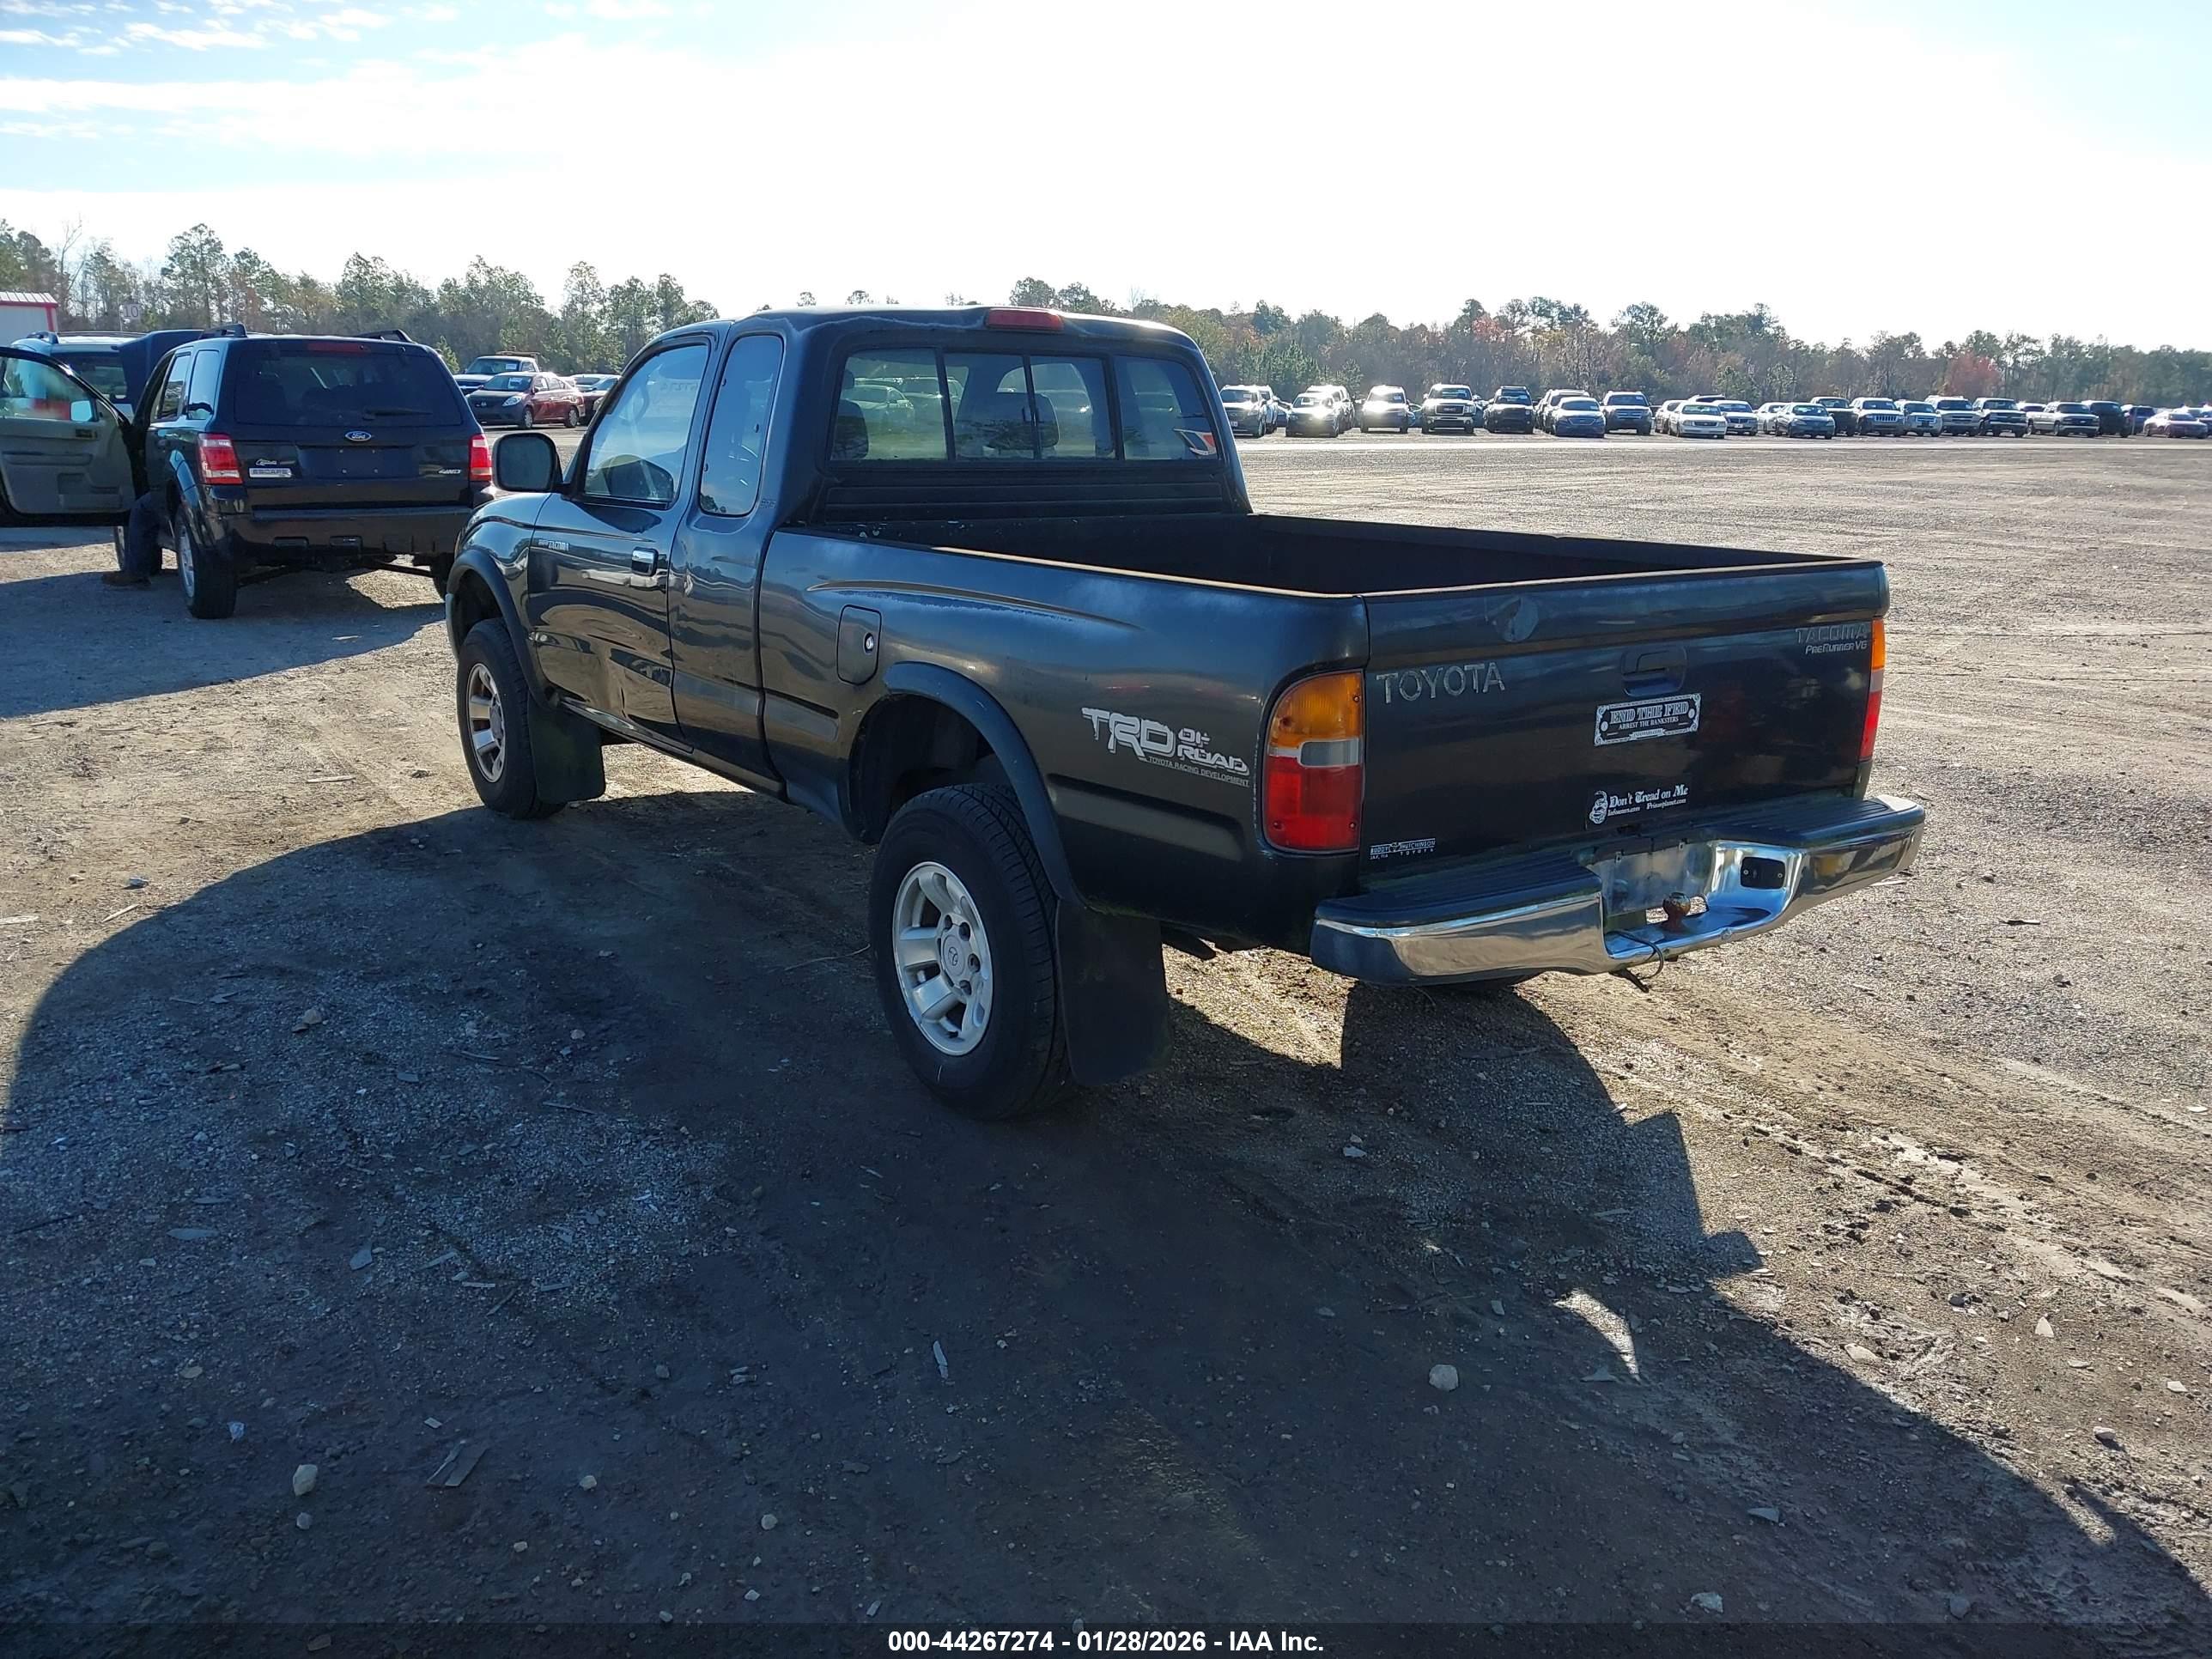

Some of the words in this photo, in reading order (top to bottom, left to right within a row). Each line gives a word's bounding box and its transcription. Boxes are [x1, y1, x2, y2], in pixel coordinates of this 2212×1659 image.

[124, 306, 139, 318] 10
[1376, 662, 1505, 703] TOYOTA
[1609, 708, 1636, 724] END
[1637, 704, 1663, 720] THE
[1663, 701, 1689, 716] FED
[1081, 708, 1176, 762] TRD
[1148, 755, 1174, 768] TOYOTA
[1175, 761, 1200, 775] RACING
[1200, 768, 1250, 787] DEVELOPMENT
[1177, 744, 1250, 776] ROAD
[1609, 793, 1633, 808] Don't
[1635, 789, 1661, 804] Tread
[1661, 790, 1671, 799] on
[1673, 784, 1689, 798] Me
